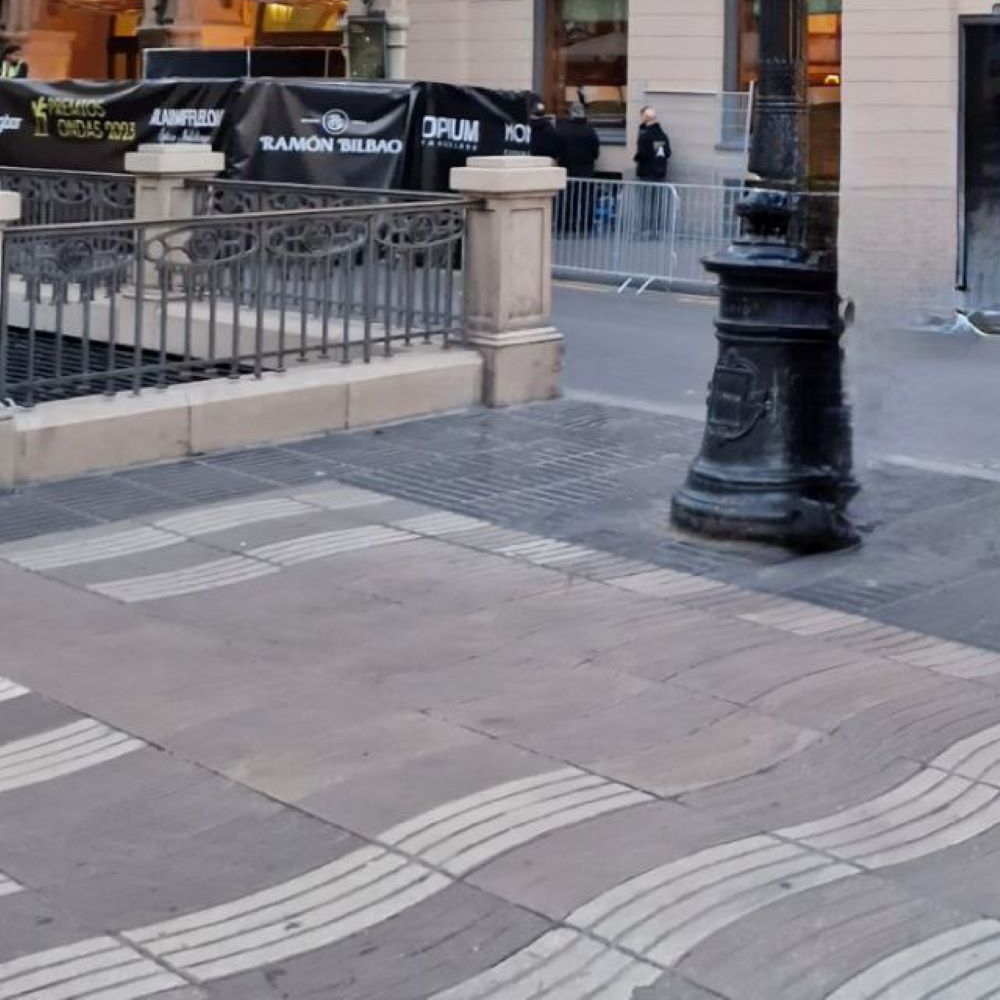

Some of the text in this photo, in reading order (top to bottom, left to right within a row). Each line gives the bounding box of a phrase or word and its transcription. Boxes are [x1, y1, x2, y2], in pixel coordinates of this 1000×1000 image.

[57, 119, 104, 139] ONDAS
[422, 115, 479, 142] OPIUM
[260, 135, 334, 152] RAMÓN
[337, 138, 403, 154] BILBAO
